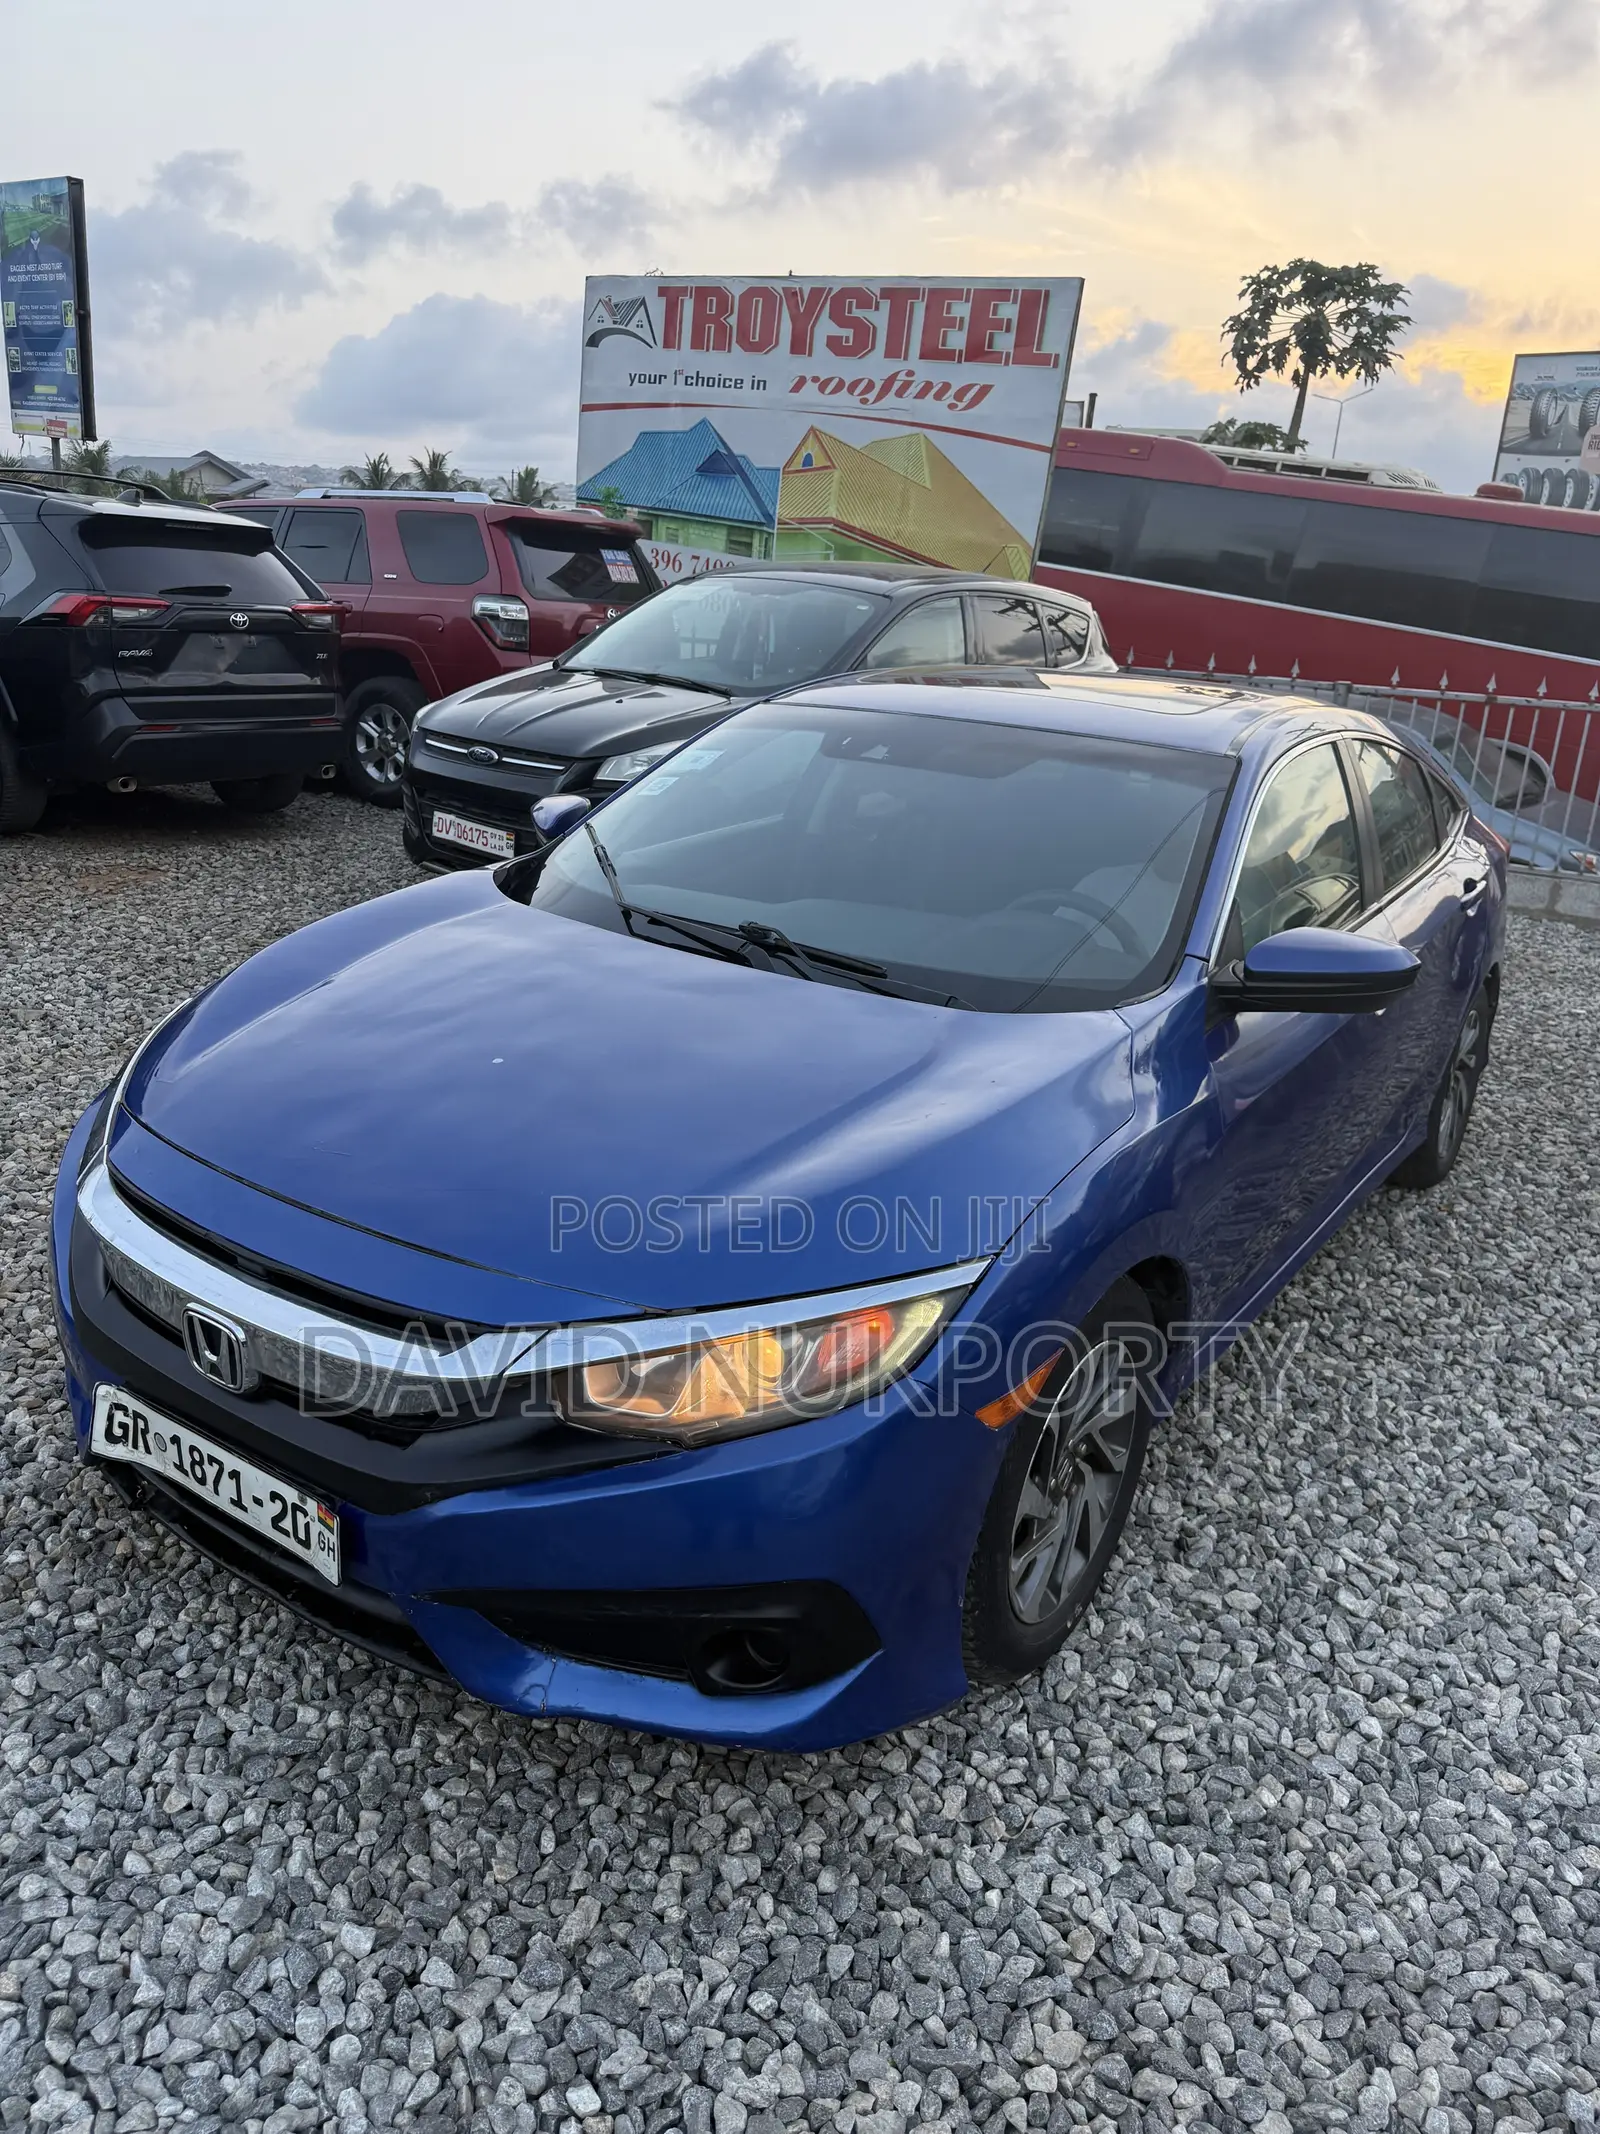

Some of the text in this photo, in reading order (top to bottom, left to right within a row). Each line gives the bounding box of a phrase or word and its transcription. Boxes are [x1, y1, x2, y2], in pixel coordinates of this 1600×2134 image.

[10, 262, 63, 273] EAGLES NEST ASTRO TURF
[18, 274, 31, 282] EVENT
[32, 273, 48, 281] CENTER
[657, 284, 1060, 369] TROYSTEEL
[628, 371, 668, 388] your
[684, 370, 744, 390] choice
[750, 375, 767, 391] in
[788, 368, 995, 412] roofing
[651, 547, 683, 573] 396
[437, 816, 452, 835] DV
[456, 822, 489, 848] D6175
[506, 841, 514, 851] GH
[104, 1402, 312, 1551] GR 1871-20
[317, 1530, 336, 1562] GH
